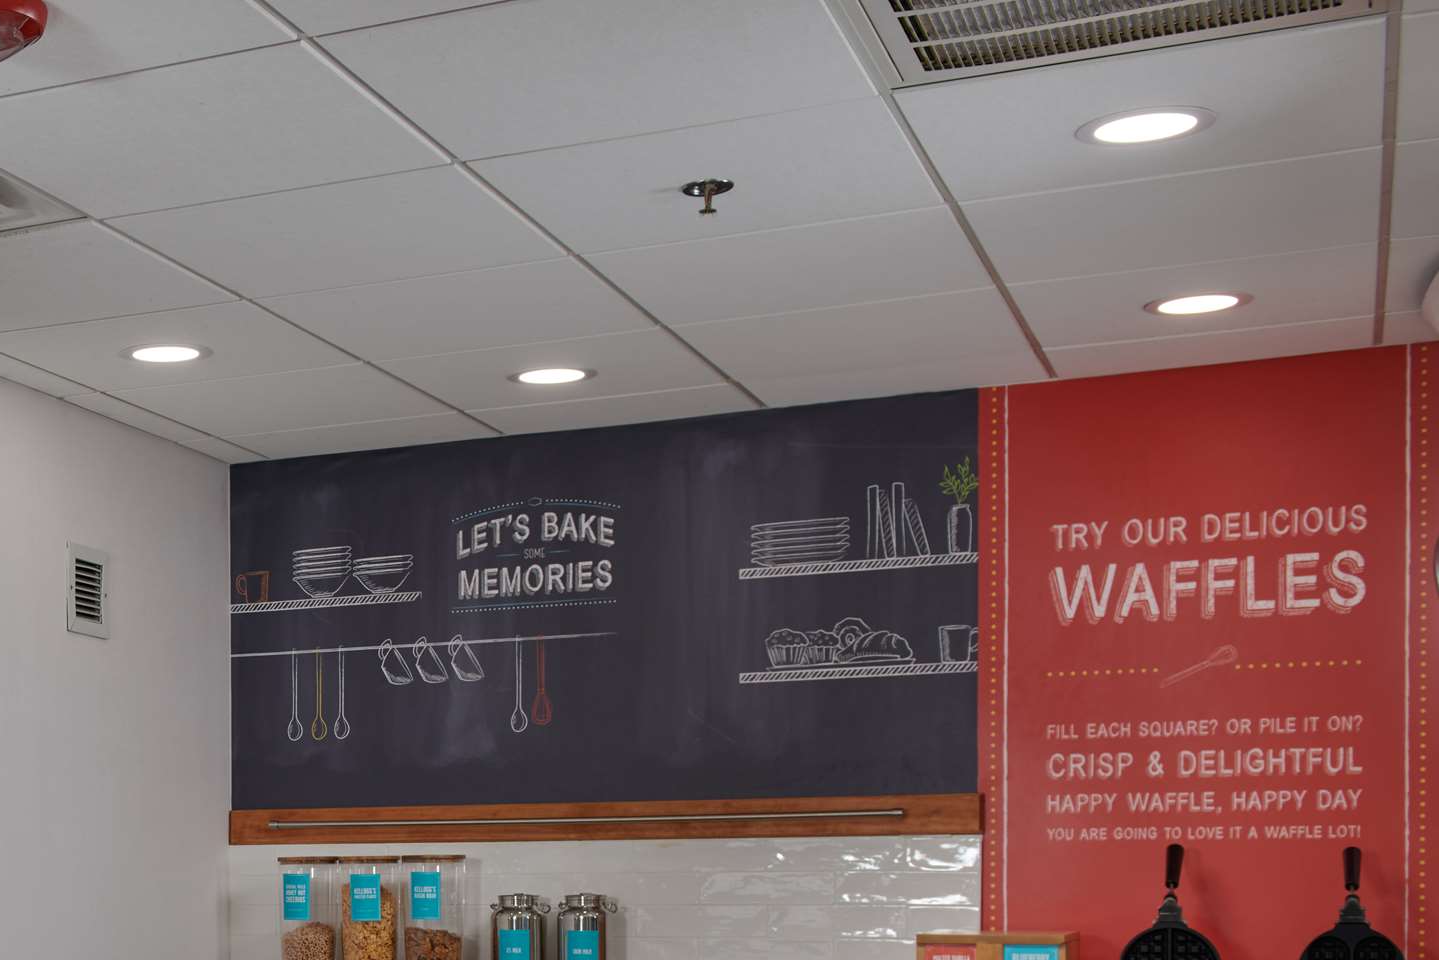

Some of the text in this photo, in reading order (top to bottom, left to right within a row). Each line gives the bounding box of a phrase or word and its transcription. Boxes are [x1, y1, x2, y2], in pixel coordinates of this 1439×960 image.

[456, 512, 615, 560] LET'S BAKE
[1050, 504, 1368, 551] TRY OUR DELICIOUS
[523, 547, 546, 560] SOME
[458, 560, 613, 600] MEMORIES
[1048, 550, 1367, 626] WAFFLES
[1046, 714, 1364, 740] FILL EACH SQUARE? OR PILE IT ON?
[1047, 746, 1364, 779] CRISP & DELIGHTFUL
[1046, 788, 1363, 814] HAPPY WAFFLE, HAPPY DAY
[1046, 824, 1361, 841] YOU ARE GOING TO LOVE IT A WAFFLE LOT!
